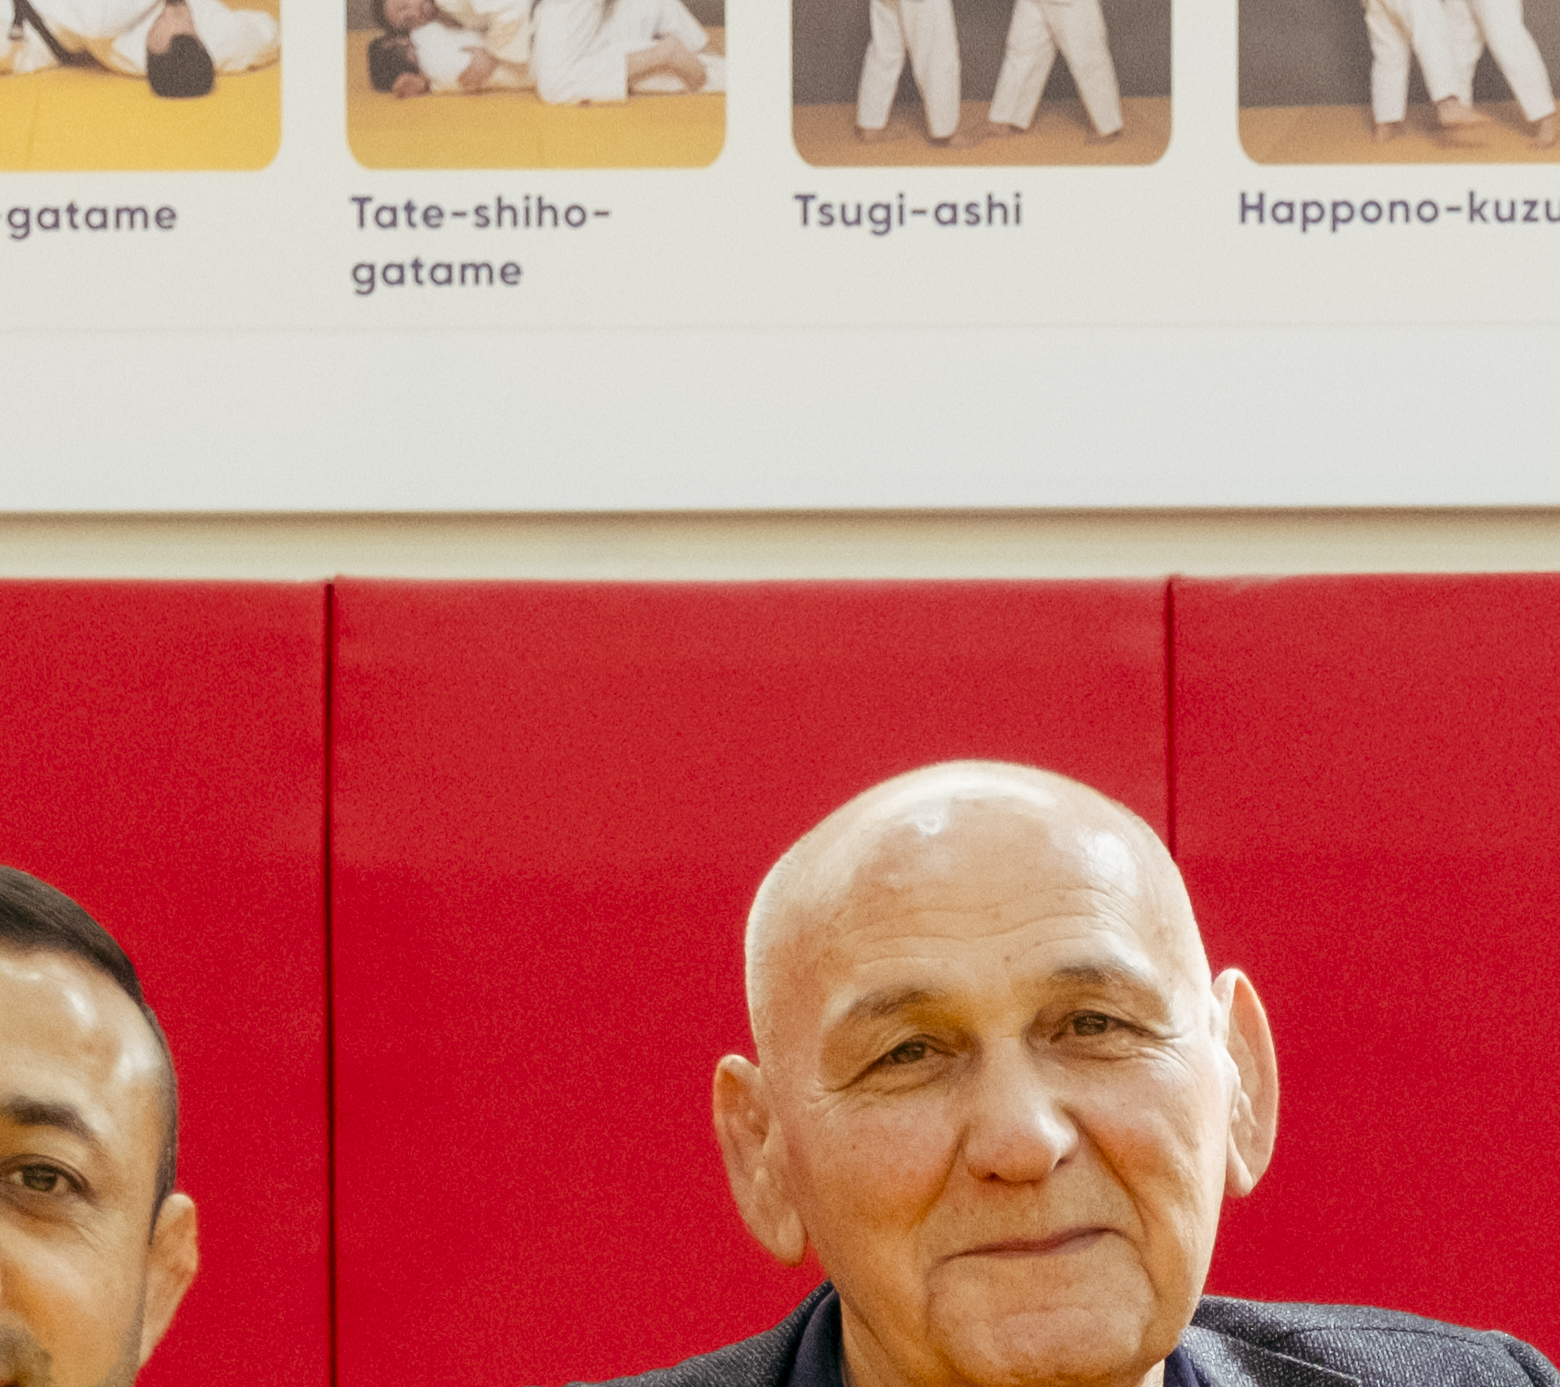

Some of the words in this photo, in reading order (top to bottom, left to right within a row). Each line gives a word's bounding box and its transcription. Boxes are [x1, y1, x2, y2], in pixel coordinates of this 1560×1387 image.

[351, 195, 611, 229] Tate-shiho-
[794, 192, 1022, 236] Tsugi-ashi
[351, 257, 523, 296] gatame
